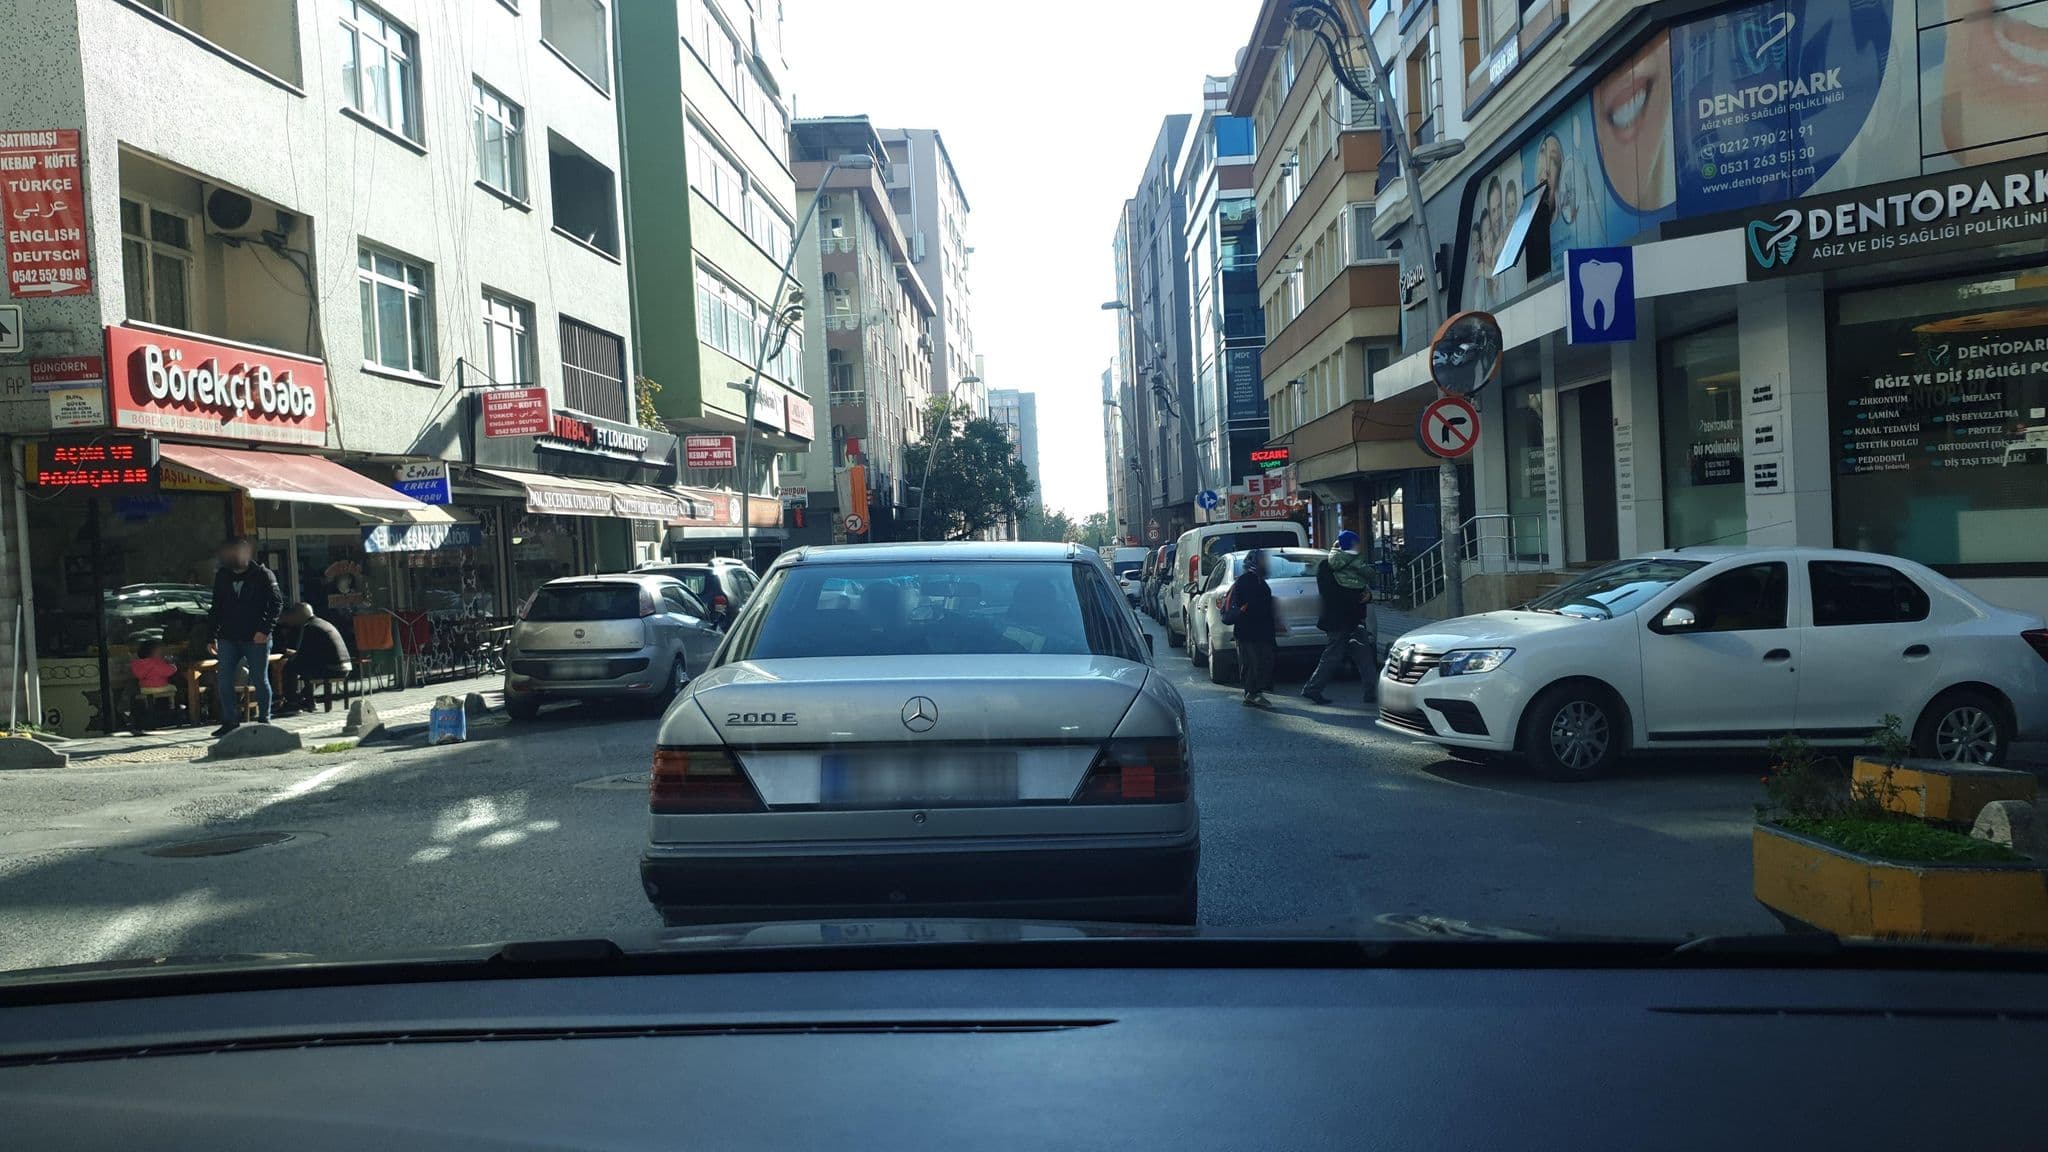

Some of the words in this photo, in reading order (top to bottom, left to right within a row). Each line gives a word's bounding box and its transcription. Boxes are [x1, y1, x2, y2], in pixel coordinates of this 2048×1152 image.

[1699, 67, 1842, 119] DENTOPARK
[1701, 120, 1721, 131] AĞIZ
[1722, 117, 1734, 127] VE
[1751, 104, 1787, 120] SAĞLIĞI
[0, 131, 57, 148] SATIRBAŞI
[1719, 138, 1749, 154] 0212
[1752, 132, 1776, 148] 790
[1779, 129, 1794, 143] 21
[1798, 124, 1814, 138] 91
[1, 156, 37, 170] KEBAP
[44, 153, 78, 169] KÖFTE
[1720, 160, 1749, 175] 0531
[1753, 154, 1776, 169] 263
[1779, 149, 1796, 163] 55
[1799, 146, 1815, 159] 30
[9, 178, 73, 193] TÜRKÇE
[1702, 165, 1815, 194] www.dentopark.com
[13, 200, 68, 222] عربي
[10, 228, 80, 243] ENGLISH
[1812, 241, 1845, 259] AĞIZ
[1848, 239, 1867, 254] VE
[1871, 232, 1895, 250] DİŞ
[1898, 223, 1960, 246] SAĞLIĞI
[13, 249, 80, 263] DEUTSCH
[12, 269, 38, 282] 0542
[39, 268, 58, 281] 552
[59, 268, 73, 281] 99
[145, 344, 254, 417] Börekçi
[259, 364, 316, 417] Baba
[1874, 374, 1910, 389] AĞIZ
[1913, 374, 1931, 385] VE
[1936, 368, 1963, 384] DİŞ
[1966, 363, 2026, 382] SAĞLIĞI
[1859, 395, 1908, 406] ZİRKONYUM
[1962, 392, 2002, 403] İMPLANT
[1868, 410, 1900, 419] LAMİNA
[1945, 413, 1960, 423] DİŞ
[1962, 409, 2019, 421] BEYAZLATMA
[1855, 427, 1881, 436] KANAL
[1883, 422, 1920, 433] TEDAVİSİ
[1968, 426, 2002, 435] PROTEZ
[1856, 439, 1889, 450] ESTETİK
[1890, 438, 1919, 448] DOLGU
[1938, 440, 1989, 452] ORTODONTİ
[1858, 453, 1905, 464] PEDODONTİ
[1945, 457, 1959, 468] DİŞ
[1959, 457, 1979, 468] TAŞI
[406, 465, 440, 479] Erdal
[404, 481, 438, 491] ERKEK
[1260, 509, 1287, 517] KEBAP
[727, 712, 777, 723] 200
[781, 712, 798, 723] E
